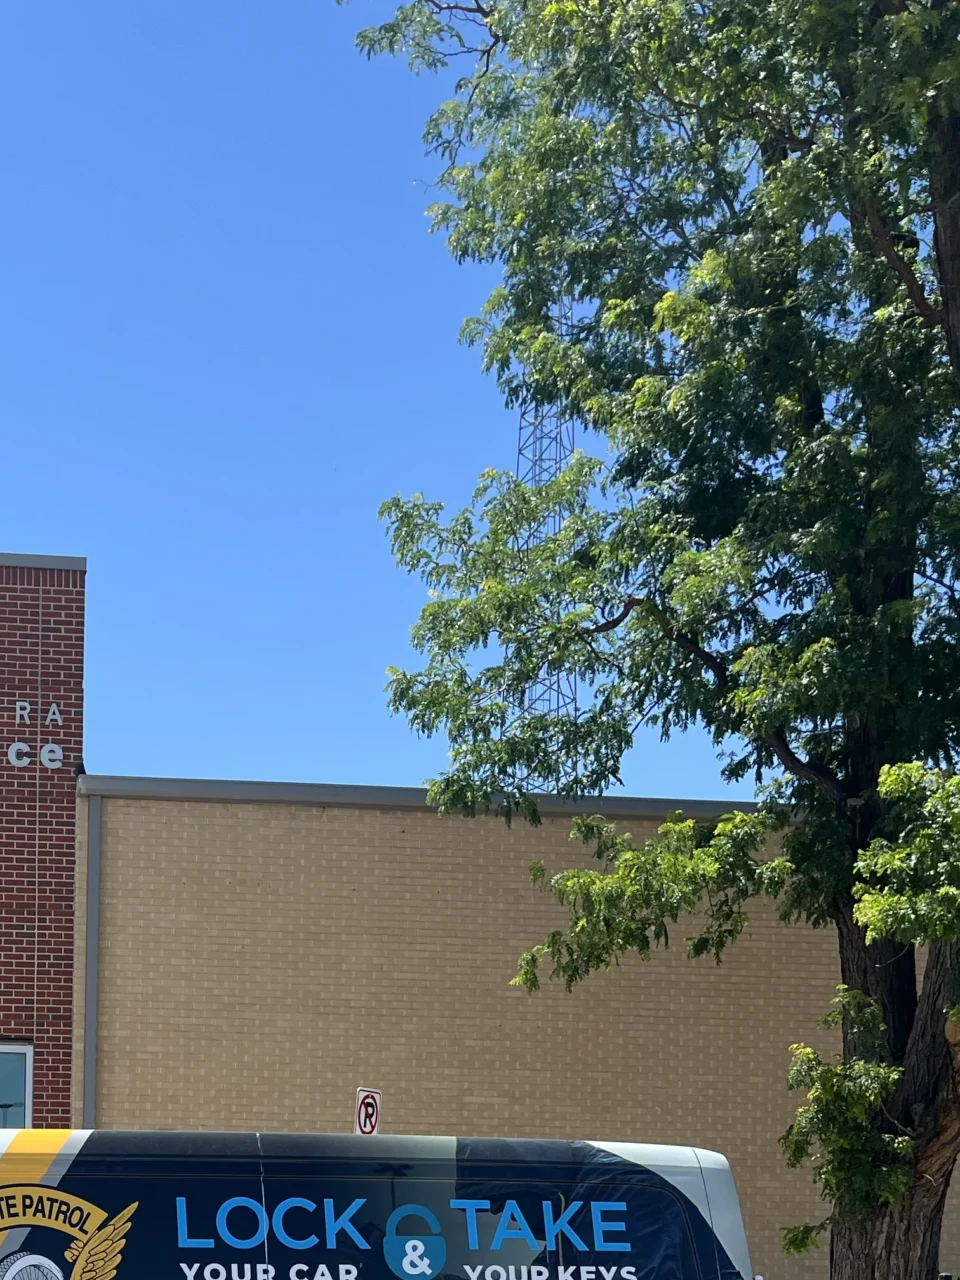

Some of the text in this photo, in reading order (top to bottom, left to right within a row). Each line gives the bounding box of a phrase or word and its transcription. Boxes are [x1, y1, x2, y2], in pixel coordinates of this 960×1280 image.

[22, 1194, 95, 1235] PATROL
[175, 1196, 632, 1252] LOCK TAKE
[401, 1239, 432, 1276] &
